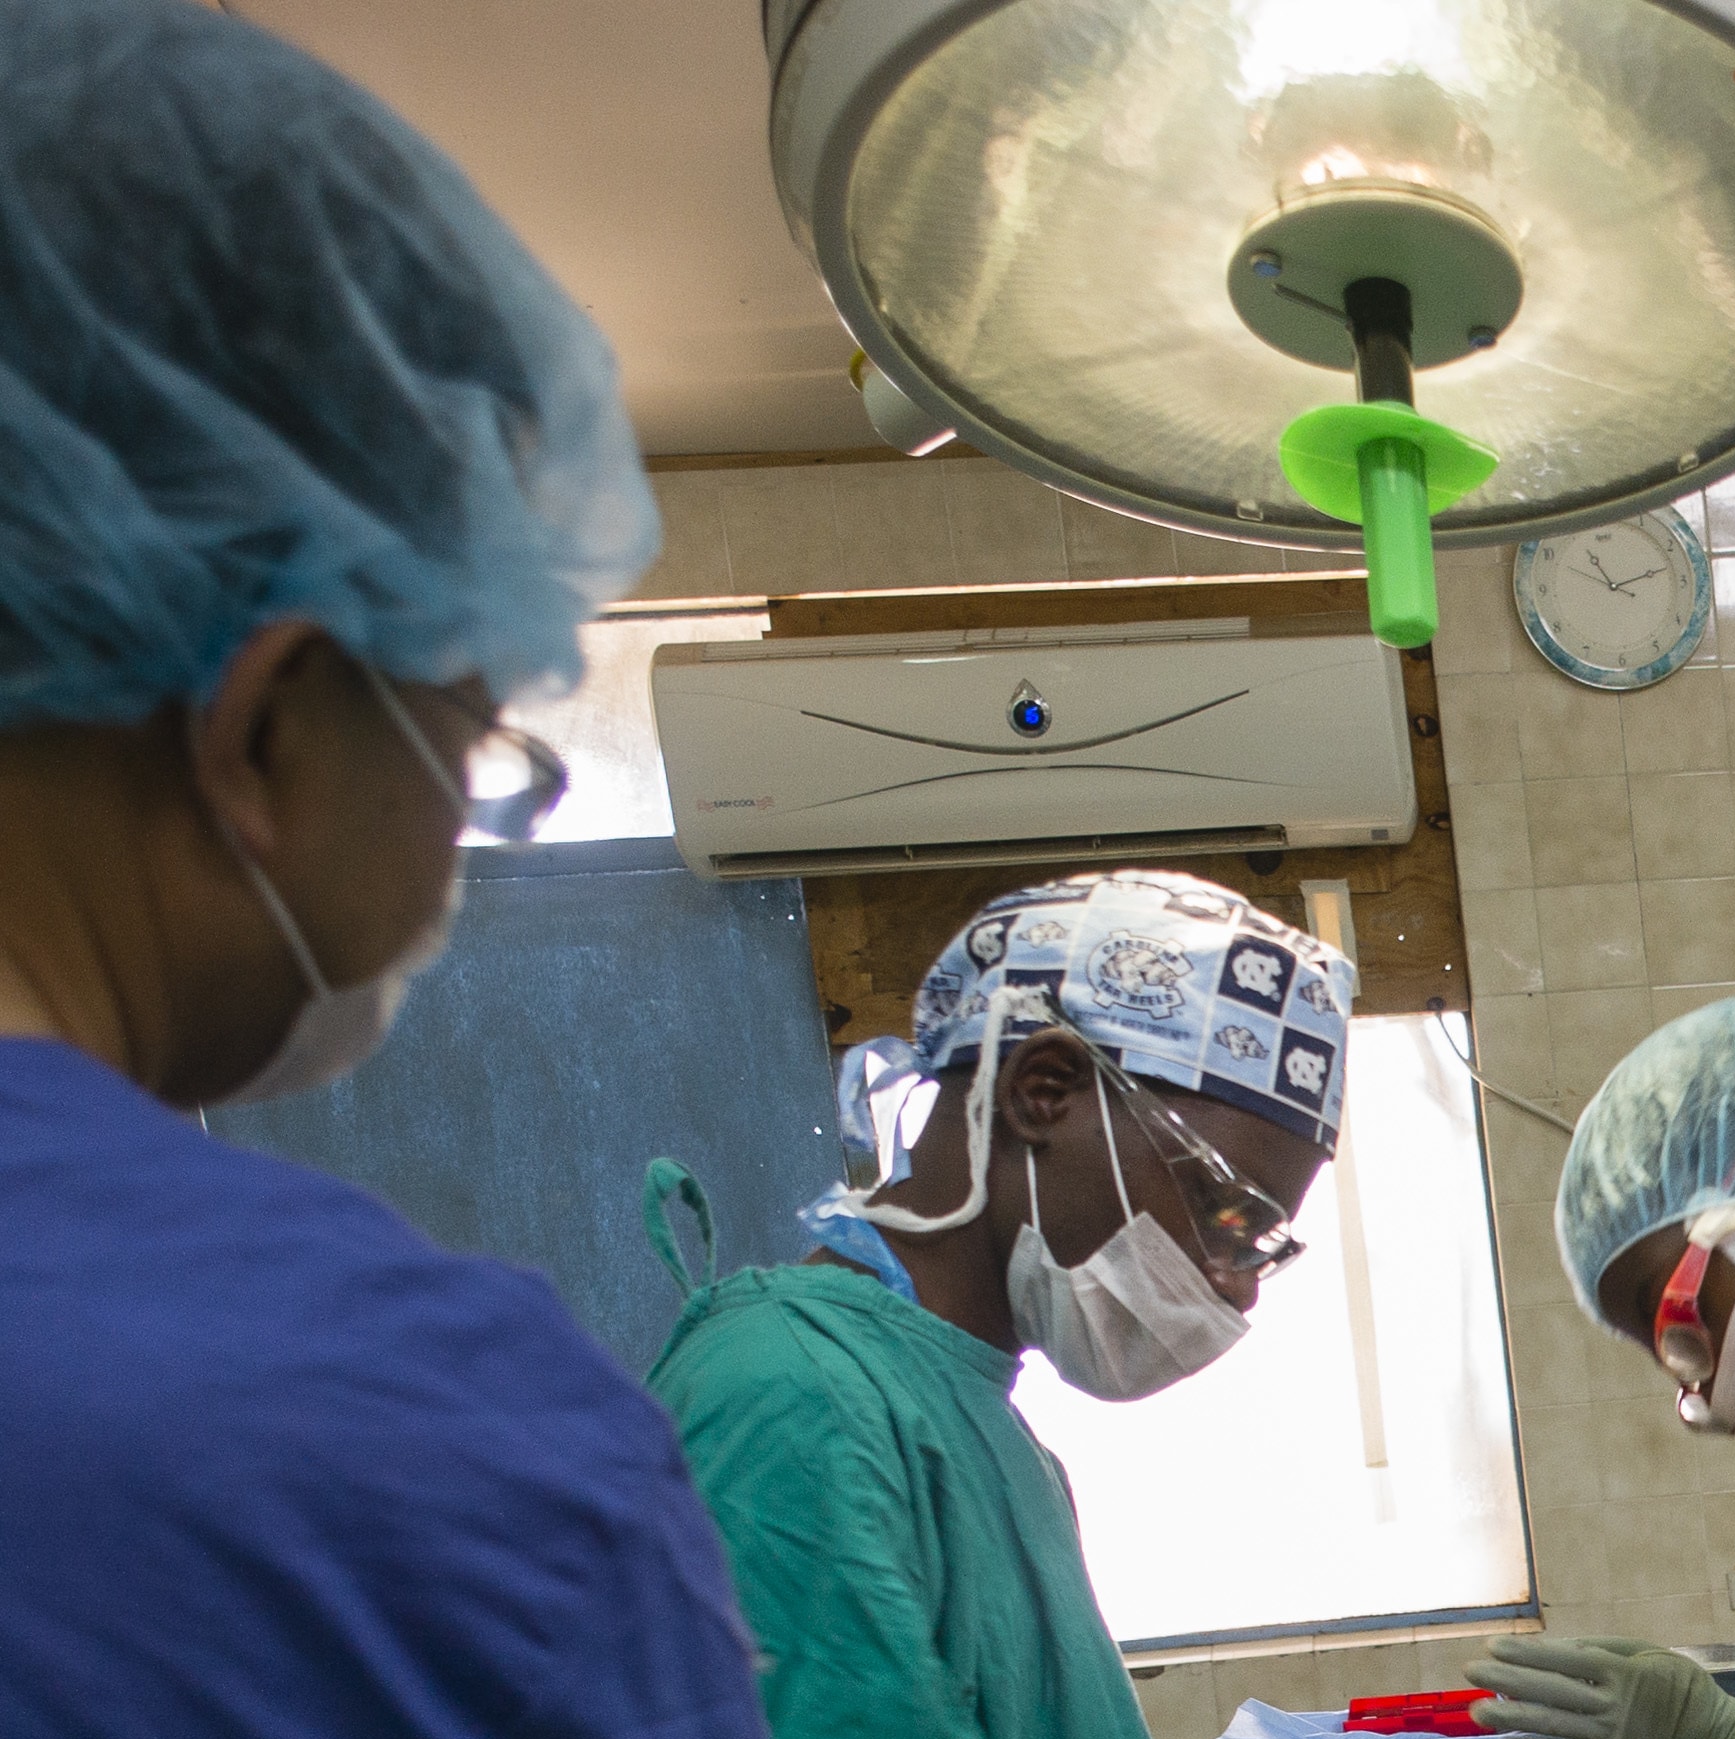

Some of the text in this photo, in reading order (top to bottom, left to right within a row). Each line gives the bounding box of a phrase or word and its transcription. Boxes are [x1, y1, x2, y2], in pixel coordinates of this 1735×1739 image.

[1667, 538, 1674, 552] 2
[1543, 547, 1555, 561] 10
[1680, 574, 1688, 589] 3
[1539, 584, 1547, 597] 9
[1553, 621, 1562, 634] 8
[1652, 640, 1660, 653] 5
[1618, 655, 1627, 667] 6
[1098, 979, 1121, 998] TAR
